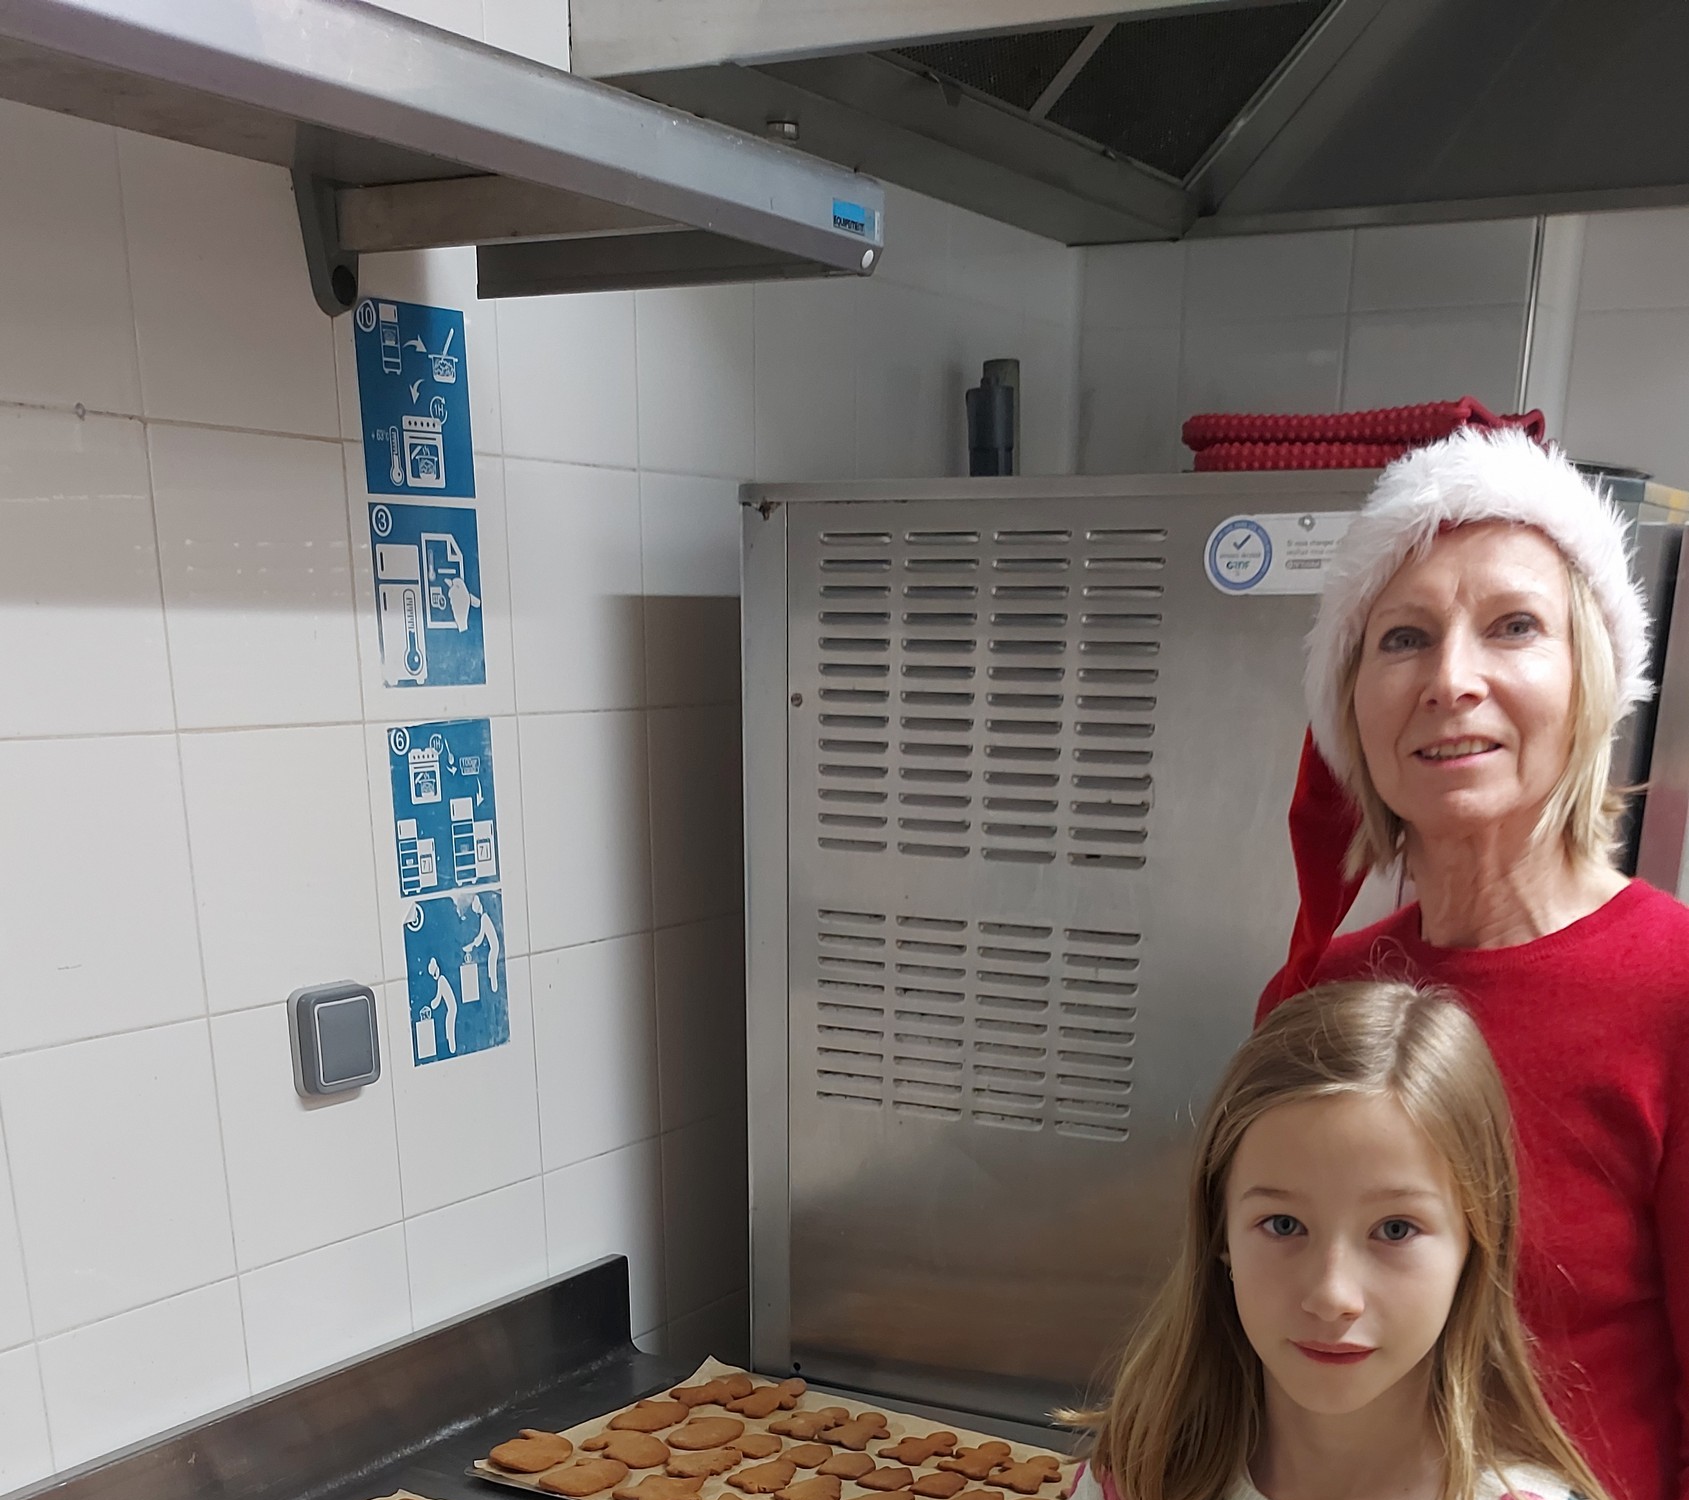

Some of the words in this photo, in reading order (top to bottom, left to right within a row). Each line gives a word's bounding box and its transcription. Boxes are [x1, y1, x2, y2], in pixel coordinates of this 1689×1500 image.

[360, 305, 374, 326] 10
[433, 404, 445, 417] 1H
[377, 511, 388, 531] 3
[395, 731, 405, 748] 6
[432, 738, 442, 750] 1H
